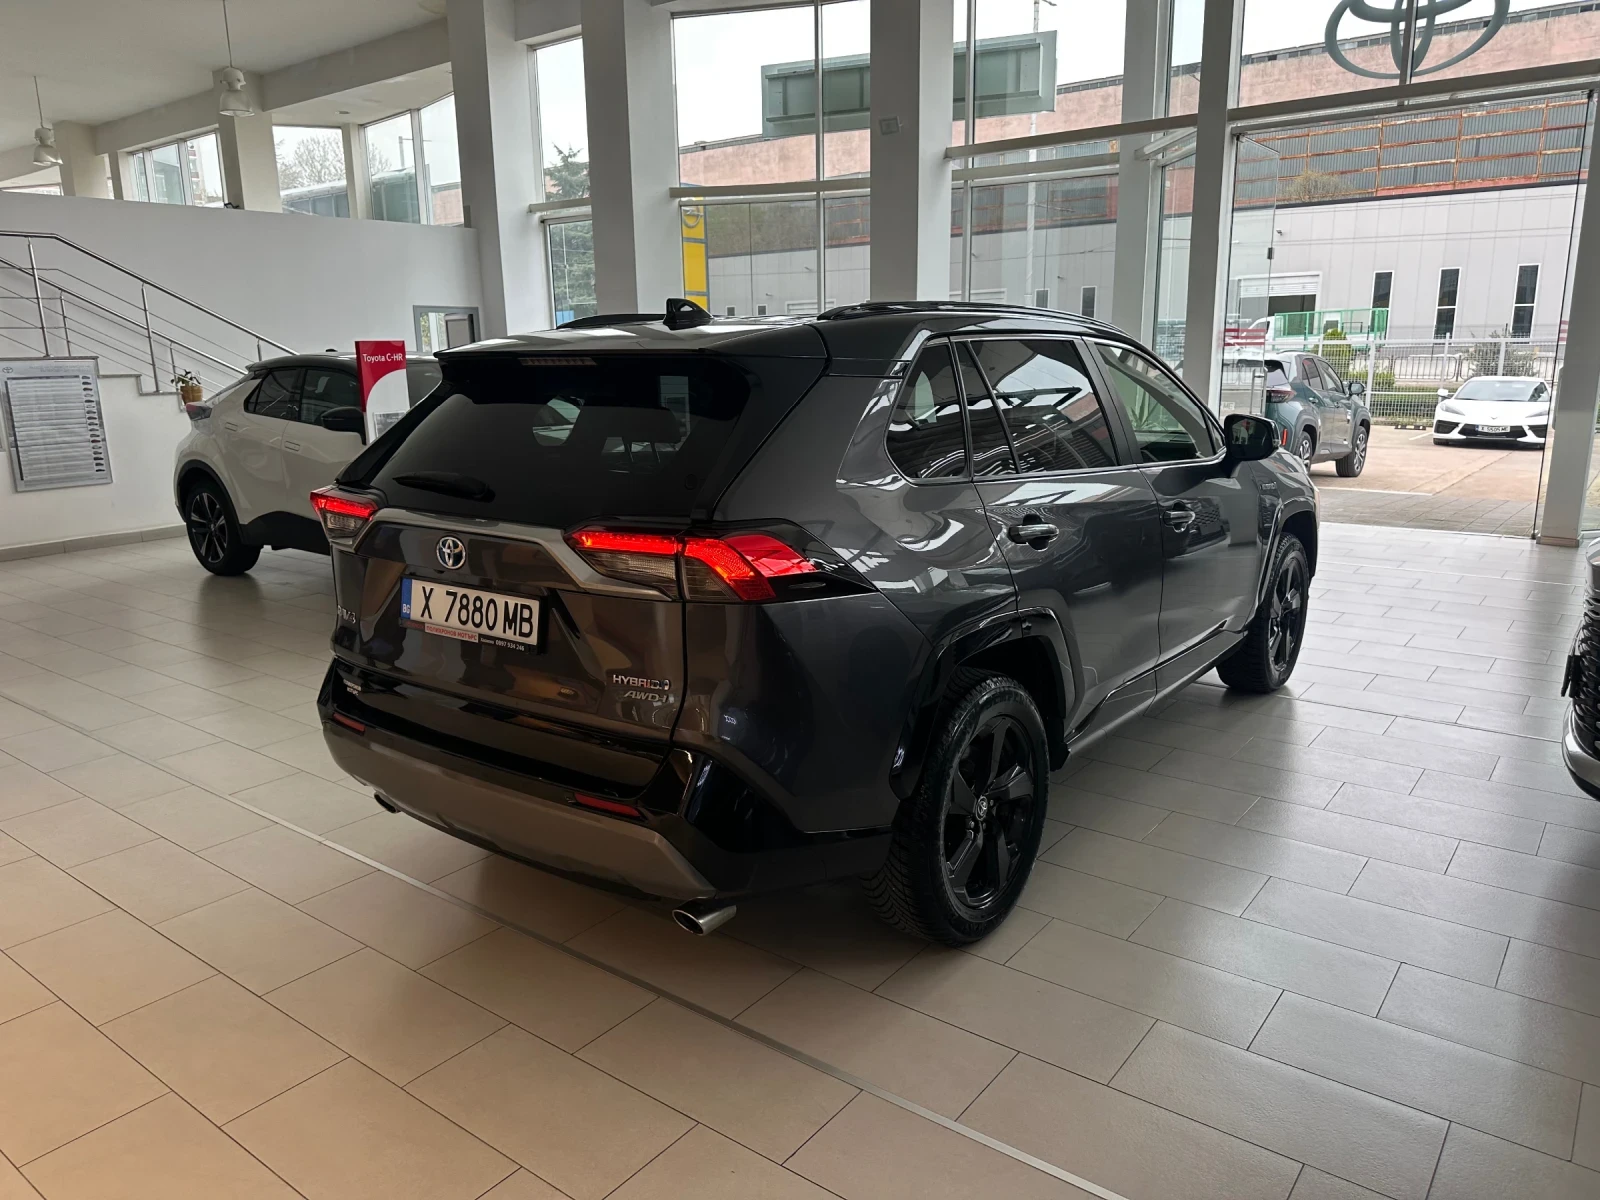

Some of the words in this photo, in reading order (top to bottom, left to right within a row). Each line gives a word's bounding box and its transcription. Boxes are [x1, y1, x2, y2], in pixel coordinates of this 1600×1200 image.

[363, 354, 385, 363] Toyota
[386, 353, 403, 362] C-HR
[402, 603, 411, 614] BG
[420, 586, 434, 619] X
[444, 590, 498, 631] 7880
[503, 600, 533, 638] MB
[613, 674, 660, 689] HYBRID
